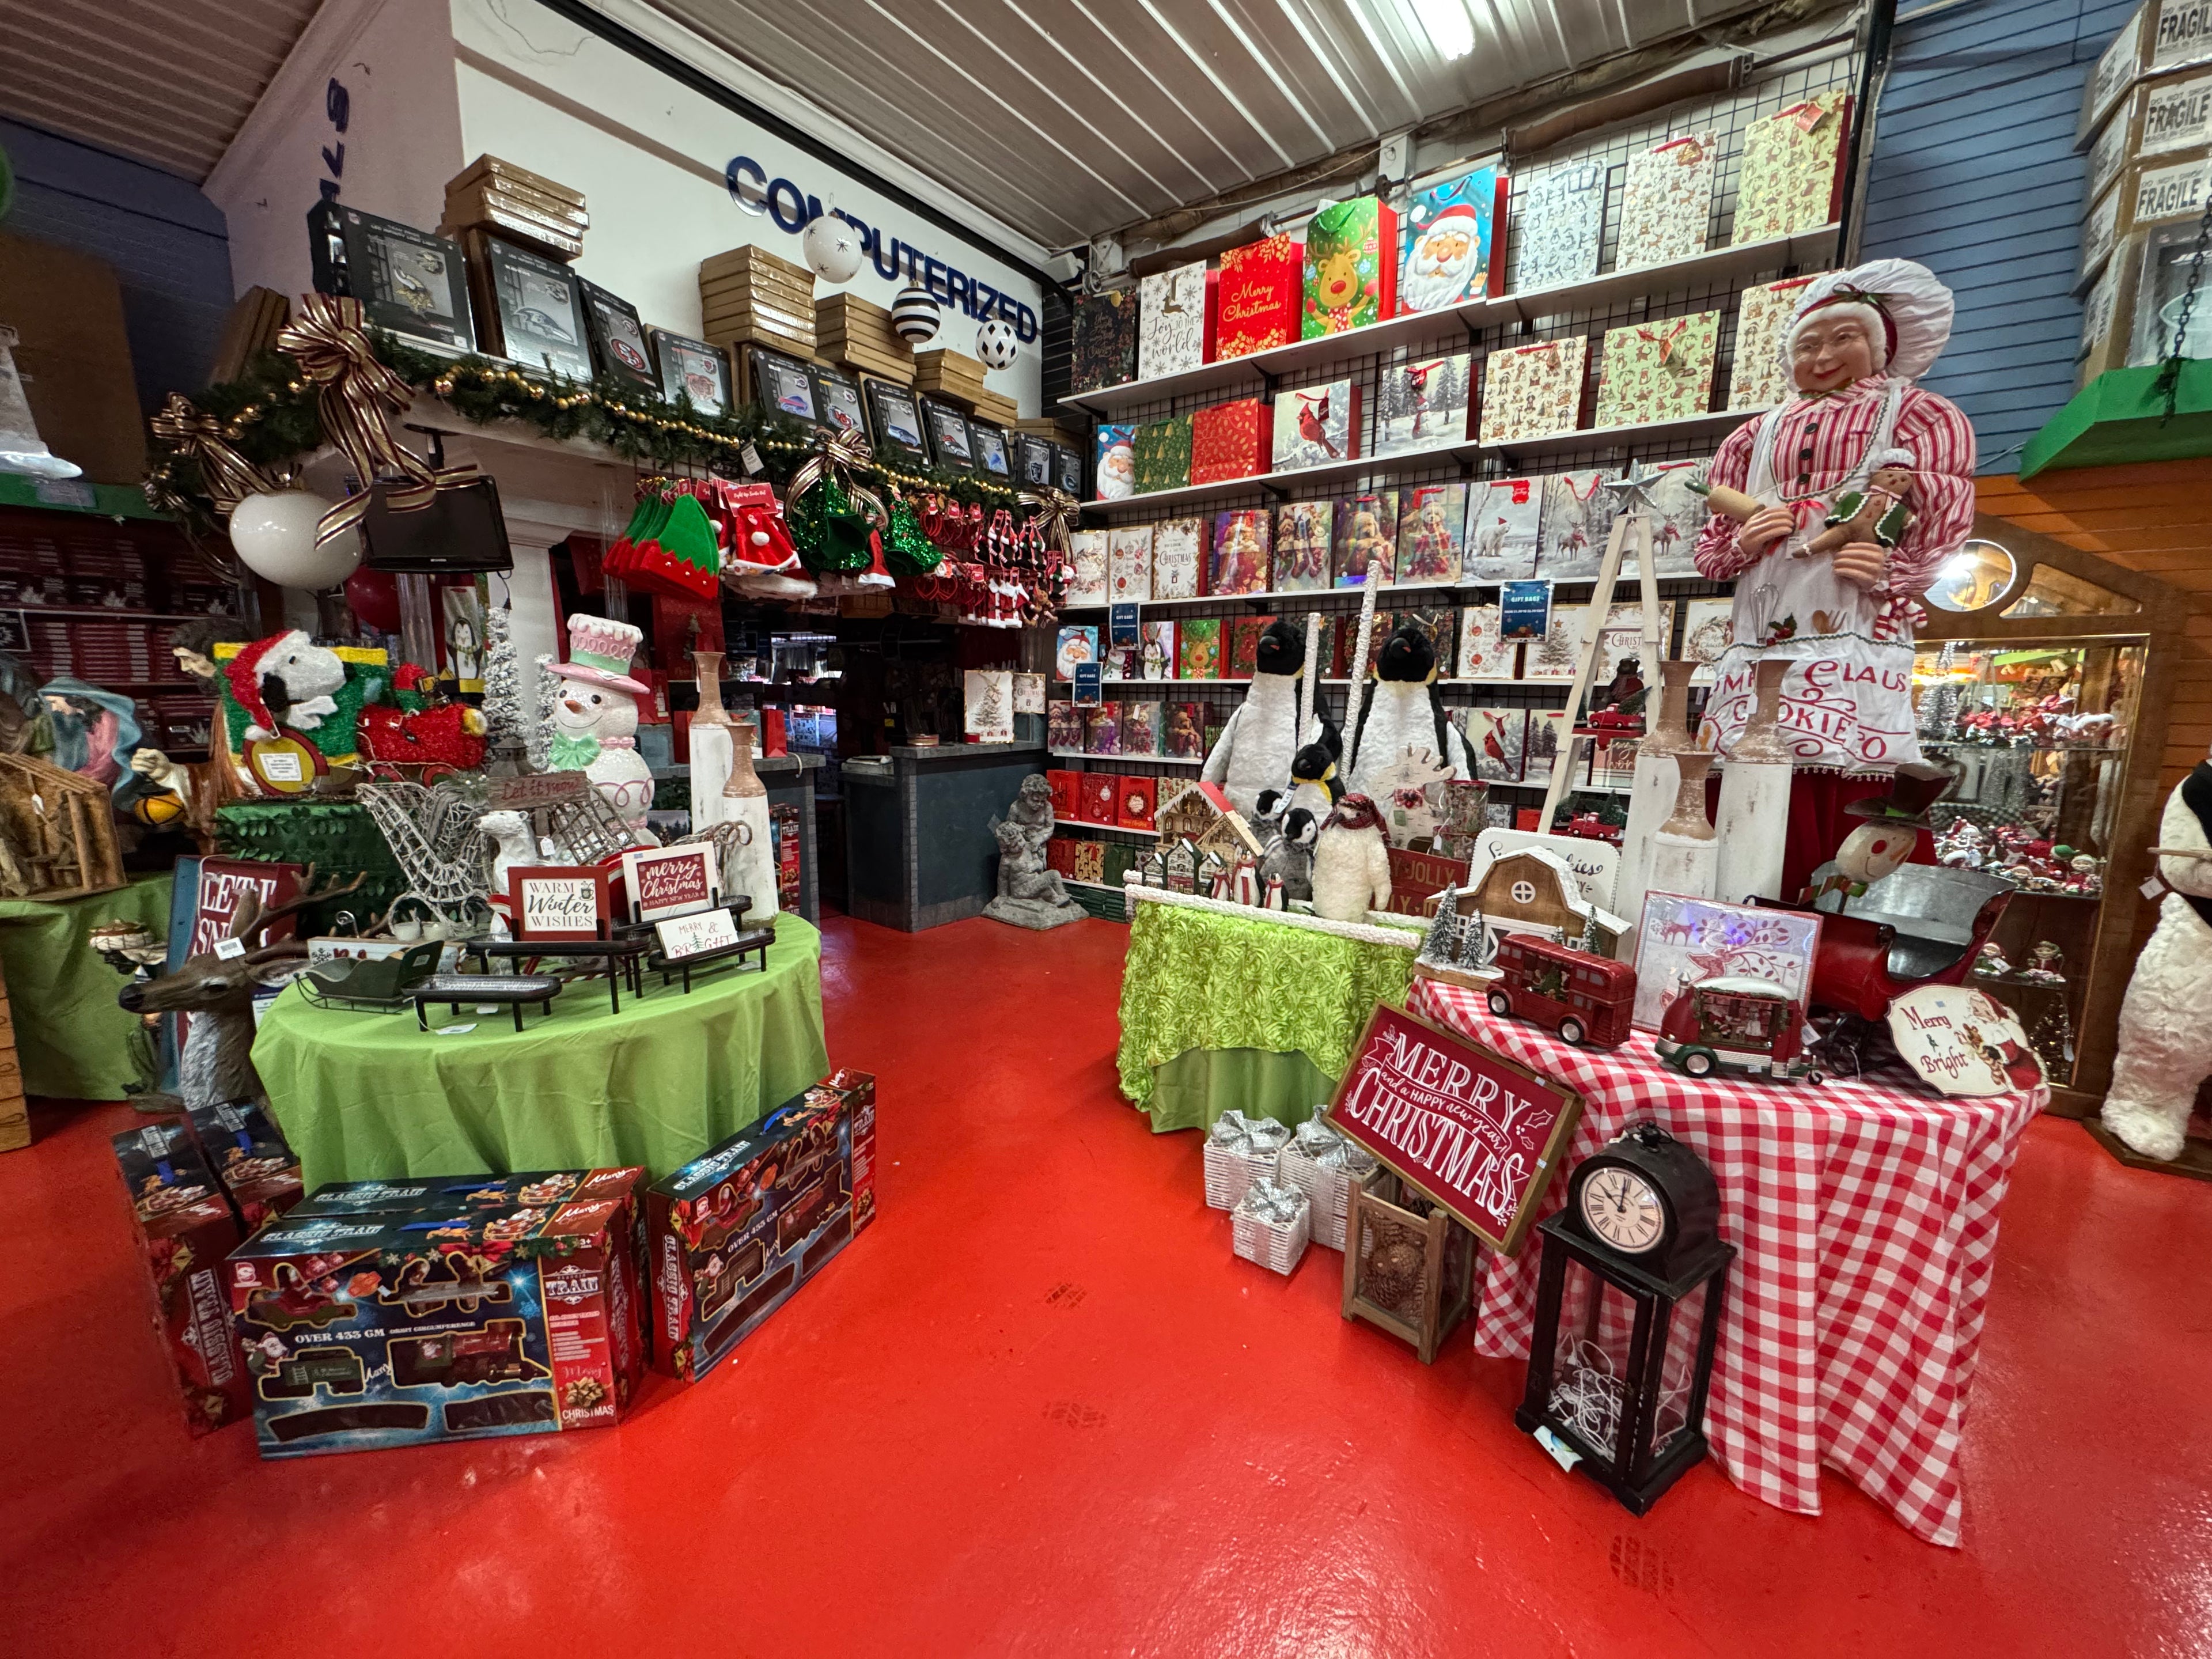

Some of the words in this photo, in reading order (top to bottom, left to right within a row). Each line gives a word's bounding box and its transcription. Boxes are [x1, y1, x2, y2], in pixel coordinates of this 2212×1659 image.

[2157, 5, 2212, 47] FRAGIL
[2146, 93, 2210, 135] FRAGILE
[2136, 178, 2202, 217] FRAGILE
[1231, 281, 1274, 302] Merry
[1223, 300, 1282, 322] Christmas
[1147, 316, 1176, 343] Joy
[1152, 327, 1195, 359] world
[1160, 550, 1191, 567] CHRISTMAS
[1612, 632, 1642, 649] CHRIST
[1804, 660, 1907, 692] CLAUS
[1733, 700, 1853, 742] COKIE
[502, 783, 527, 801] Let
[529, 778, 544, 797] it
[646, 861, 702, 880] merry
[1405, 859, 1456, 889] JOLLY
[528, 882, 575, 894] WARM
[642, 874, 703, 899] Christmas
[528, 894, 594, 916] Winter
[649, 898, 668, 906] HAPPY
[531, 916, 593, 927] WISHES
[678, 922, 703, 935] MERRY
[1899, 1006, 1953, 1031] Merry
[1920, 1046, 1968, 1080] Bright
[1388, 1032, 1532, 1135] MERRY
[1380, 1070, 1401, 1090] and
[1400, 1085, 1410, 1096] a
[1410, 1089, 1445, 1111] HAPPY
[1445, 1103, 1474, 1125] new
[1350, 1066, 1525, 1216] CHRISTMAS
[313, 1191, 380, 1203] CLASSIC
[378, 1187, 427, 1199] TRAIN
[259, 1228, 334, 1243] CLASSIC
[330, 1224, 386, 1237] TRAIN
[727, 1232, 751, 1253] OVER
[546, 1277, 599, 1296] TRAIN
[294, 1332, 333, 1344] OVER
[562, 1405, 615, 1421] CHRISTMAS
